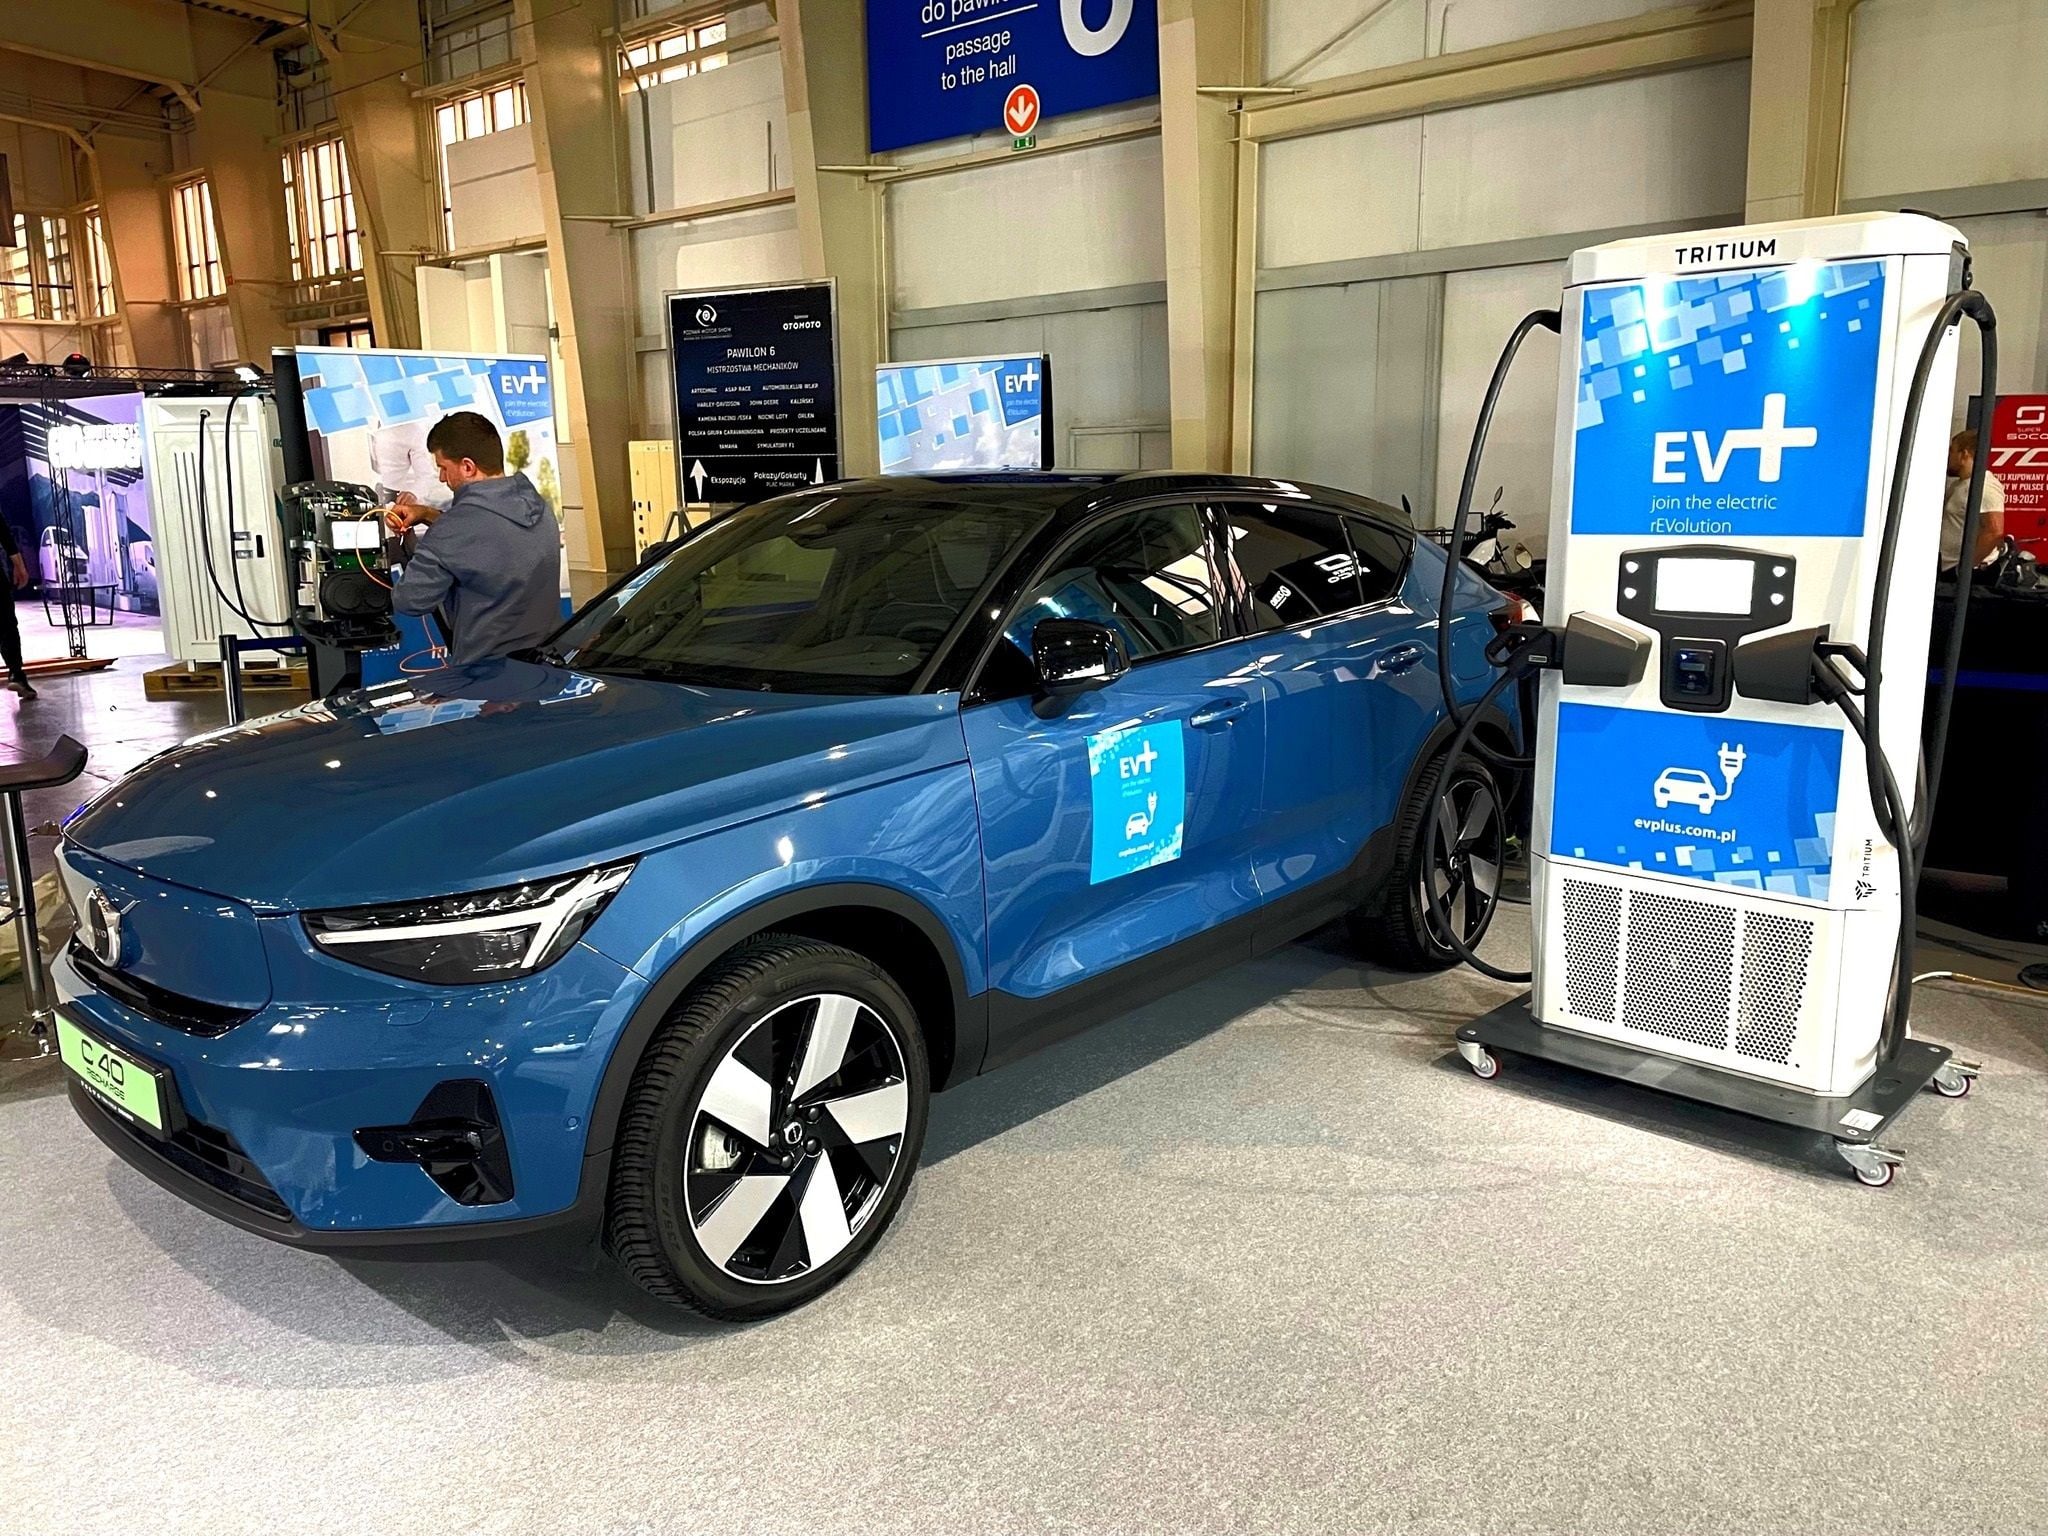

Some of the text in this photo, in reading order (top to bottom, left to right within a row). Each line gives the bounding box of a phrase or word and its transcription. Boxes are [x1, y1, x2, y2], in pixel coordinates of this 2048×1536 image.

[921, 0, 945, 24] do
[946, 30, 1011, 65] passage
[941, 54, 1016, 90] to the hall
[1675, 238, 1777, 265] TRITIUM
[782, 320, 822, 331] OTOMOTO
[727, 346, 776, 359] PAWILON 6
[706, 361, 799, 374] MISTRZOSTWA MECHANIKÓW
[1652, 392, 1818, 484] EV+
[710, 476, 746, 485] Ekspozycja
[1649, 493, 1778, 514] join the electric
[1650, 517, 1732, 533] rEVolution
[1634, 818, 1737, 844] evplus.com.pl
[1862, 838, 1873, 877] TRITIUM
